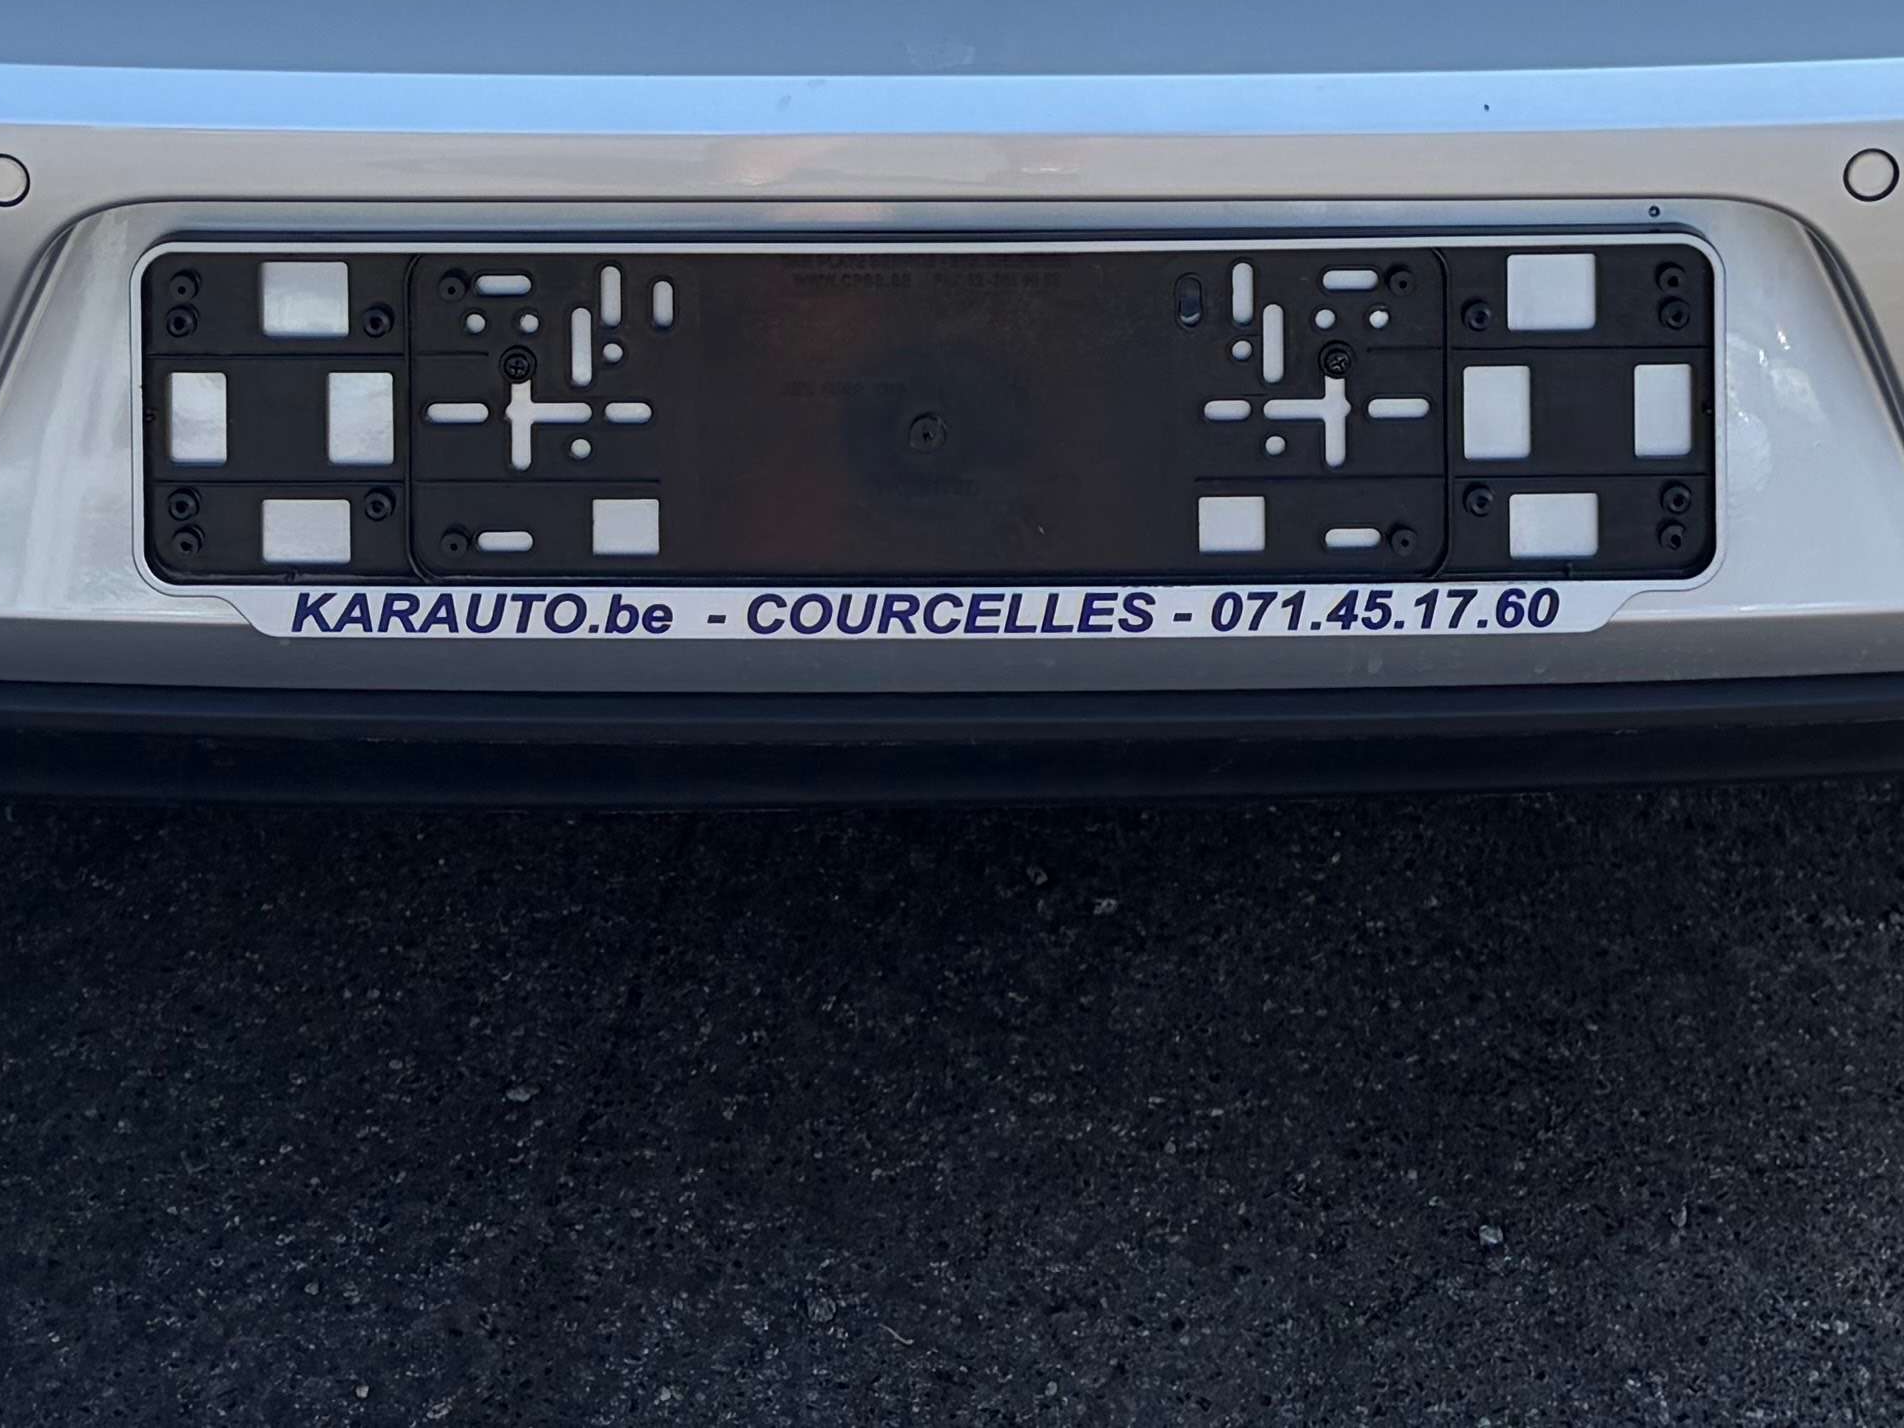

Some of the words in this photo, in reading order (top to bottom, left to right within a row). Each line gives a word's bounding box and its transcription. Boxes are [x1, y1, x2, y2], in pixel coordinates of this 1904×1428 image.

[291, 592, 674, 634] KARAUTO.be
[746, 591, 1157, 635] COURCELLES
[1210, 586, 1561, 633] 071.45.17.60
